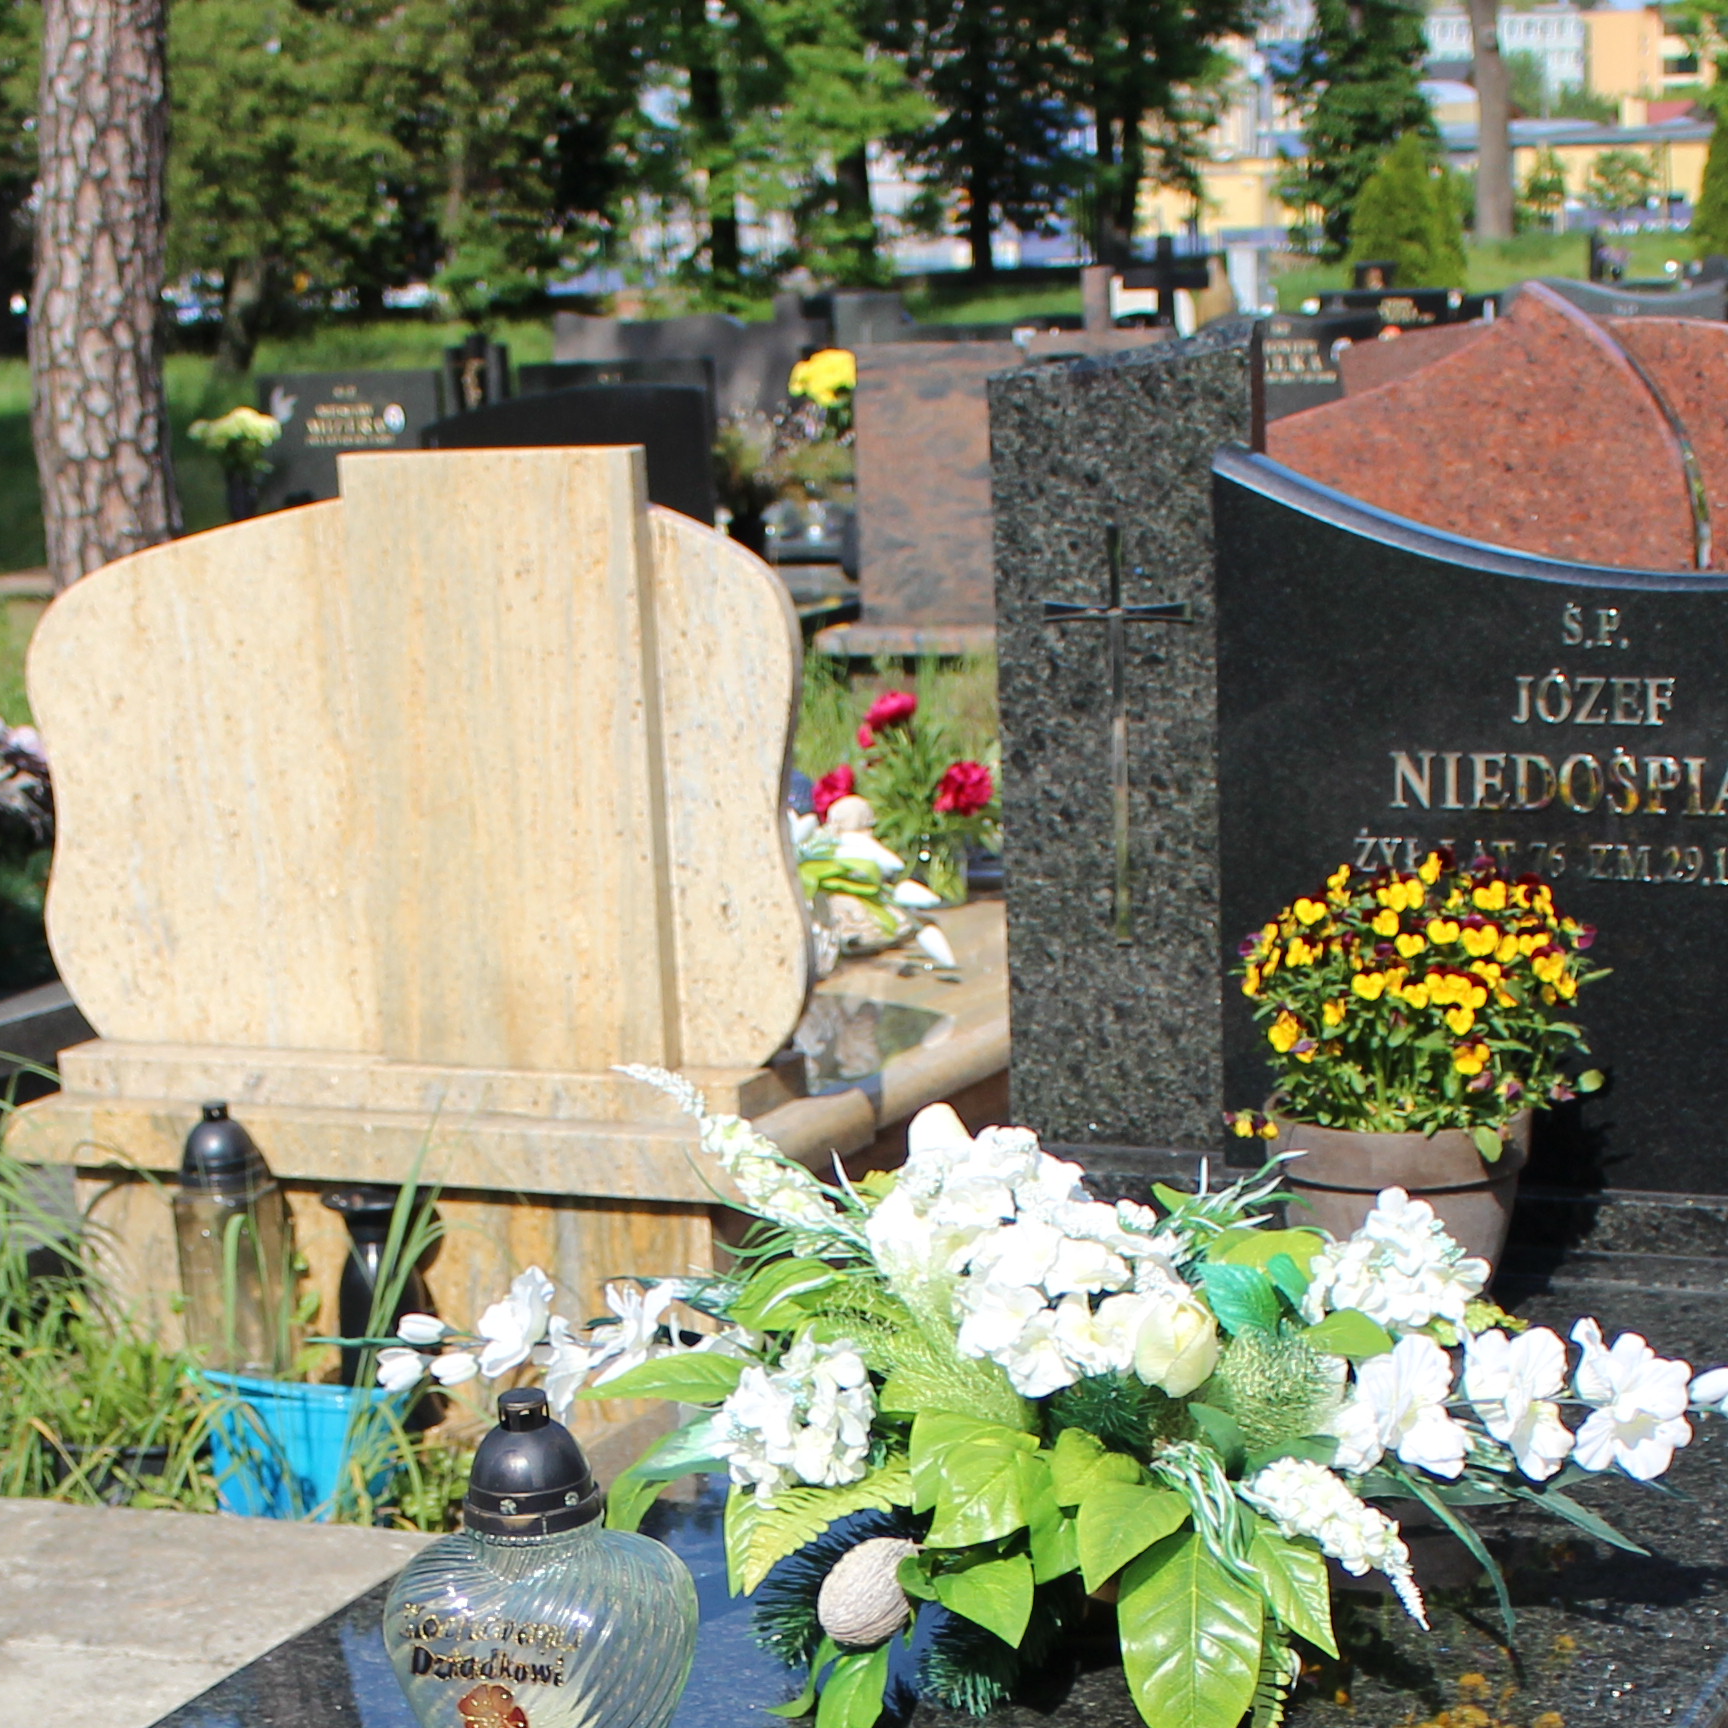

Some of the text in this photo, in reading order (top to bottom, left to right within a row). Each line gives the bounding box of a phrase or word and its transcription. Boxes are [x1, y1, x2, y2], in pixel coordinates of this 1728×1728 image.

[1562, 602, 1630, 649] Ś.P.
[1512, 668, 1676, 725] JÓZEF
[1353, 827, 1423, 873] ŻYŁ
[410, 1643, 565, 1688] Dziadkowi
